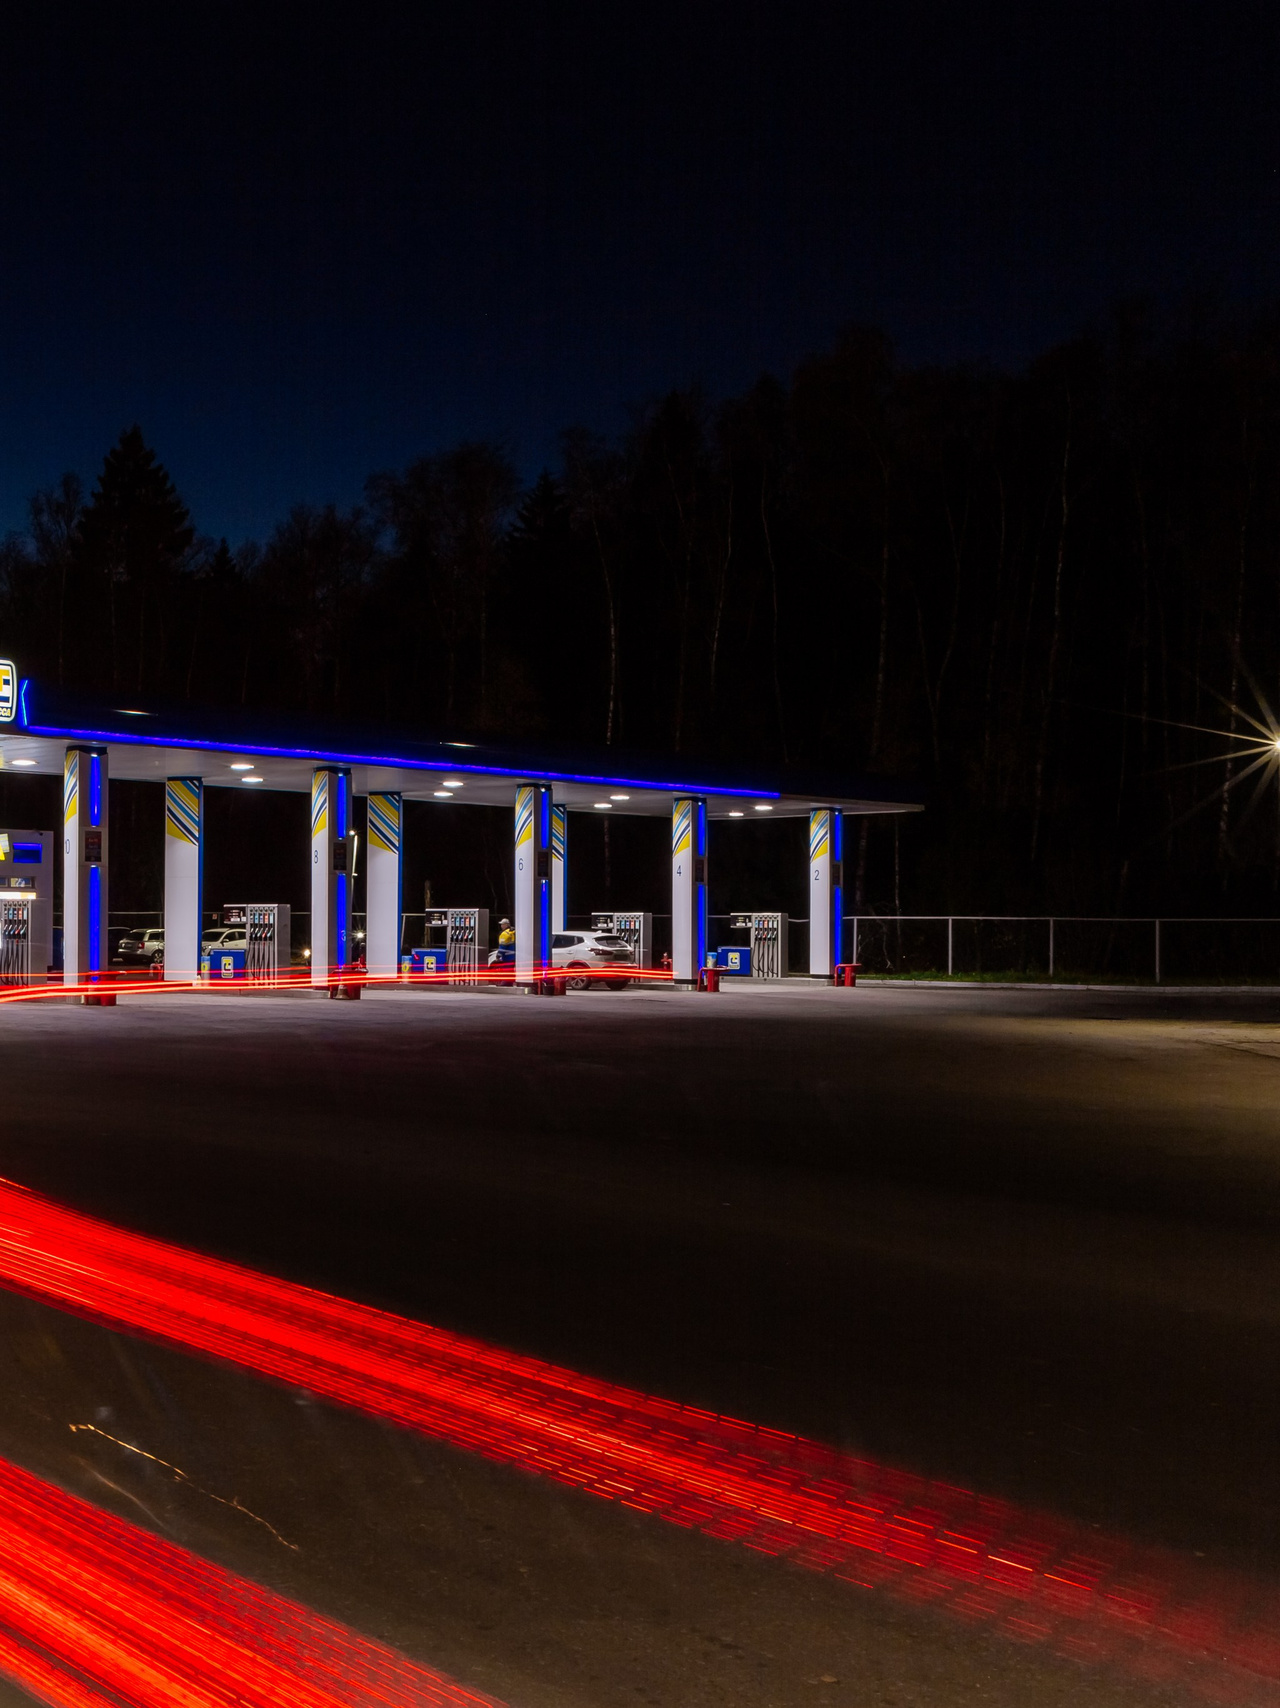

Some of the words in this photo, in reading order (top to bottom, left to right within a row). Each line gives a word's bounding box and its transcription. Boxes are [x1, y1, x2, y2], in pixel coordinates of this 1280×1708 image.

[313, 849, 319, 864] 8
[518, 857, 524, 871] 6
[676, 865, 682, 877] 4
[814, 869, 820, 881] 2
